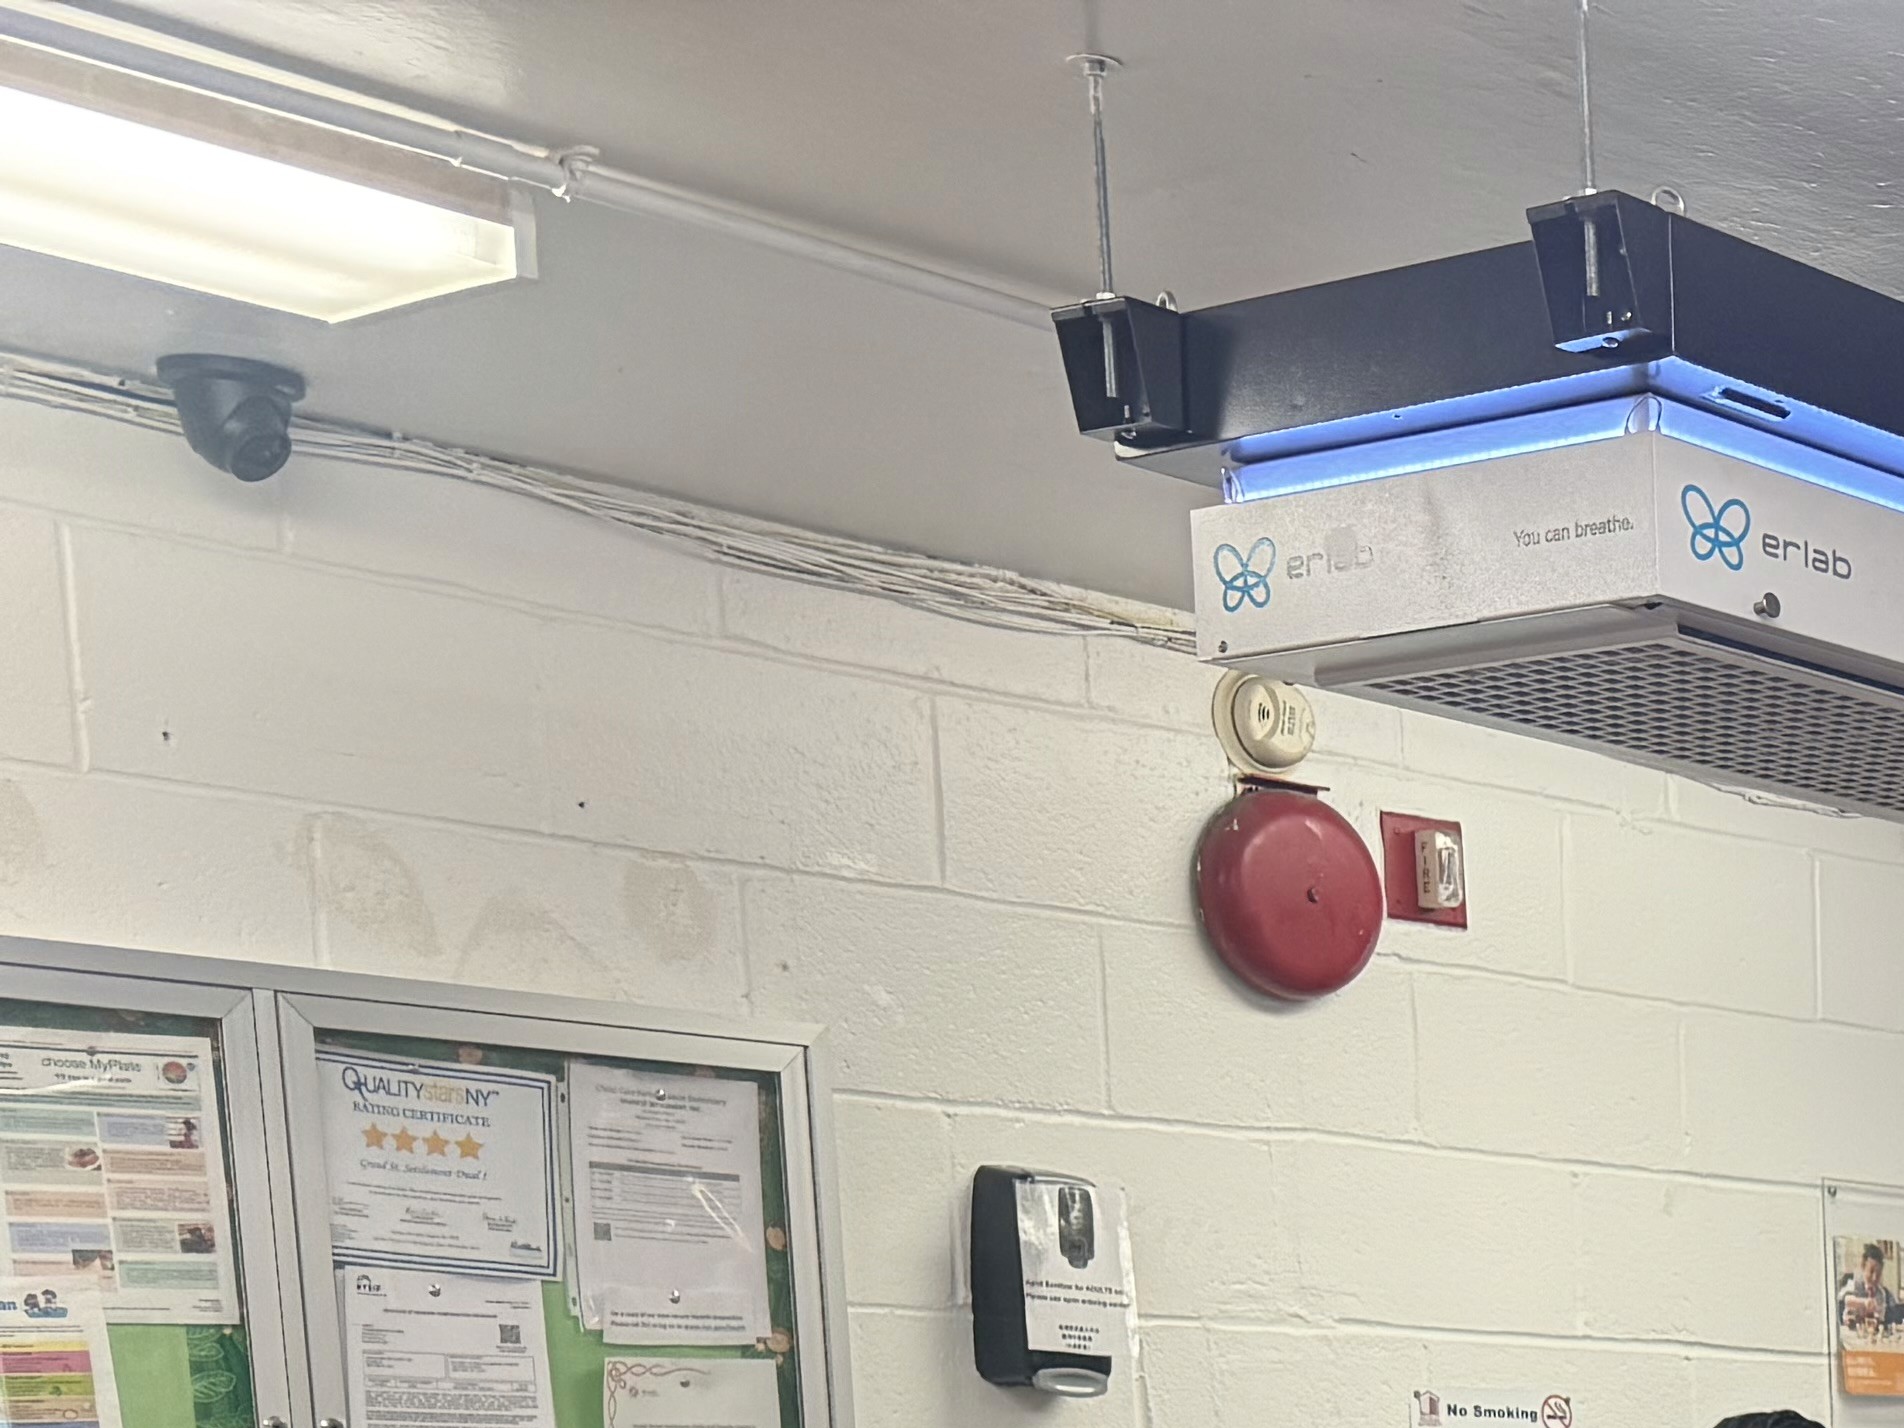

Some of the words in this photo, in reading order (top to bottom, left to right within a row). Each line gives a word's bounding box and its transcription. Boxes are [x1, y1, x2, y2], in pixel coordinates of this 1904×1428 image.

[1513, 528, 1542, 548] You
[1545, 524, 1570, 544] can
[1573, 515, 1635, 540] breathe.
[1286, 542, 1374, 580] erlab
[1760, 532, 1853, 581] erlab
[1421, 841, 1432, 894] FIRE
[353, 1100, 400, 1119] RATING
[402, 1109, 491, 1128] CERTIFICATE
[1446, 1403, 1468, 1417] No
[1473, 1405, 1539, 1423] Smoking
